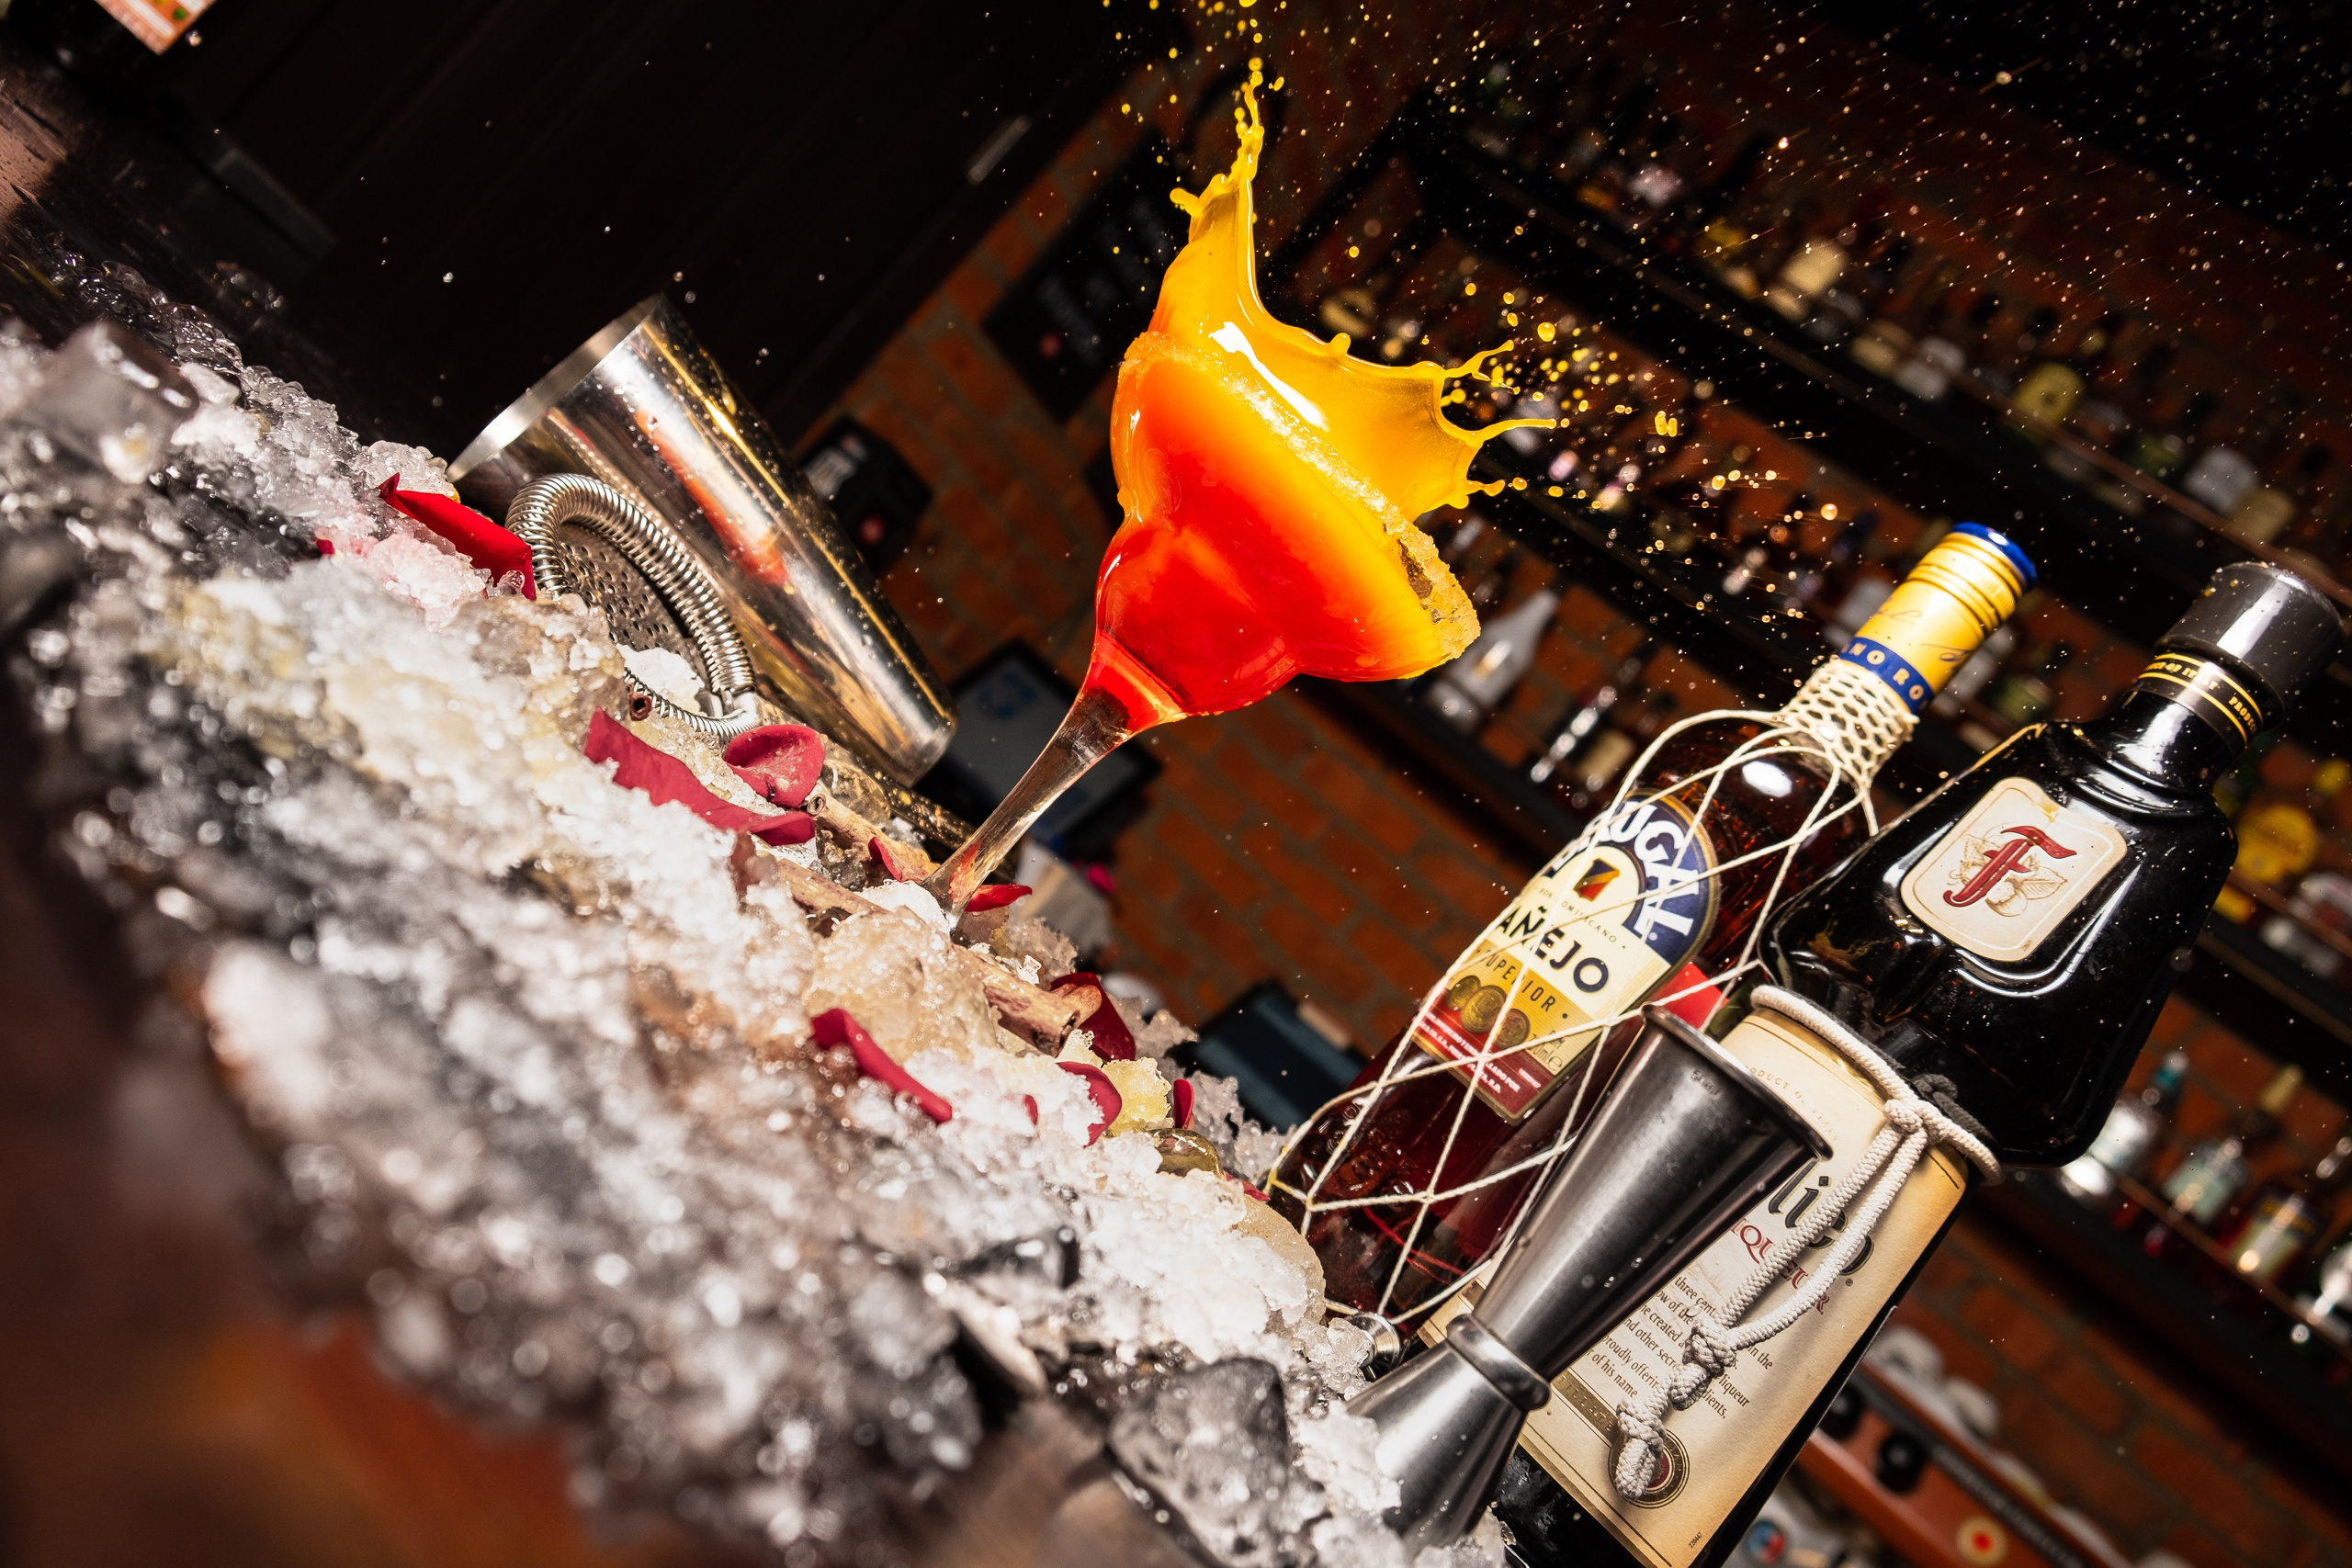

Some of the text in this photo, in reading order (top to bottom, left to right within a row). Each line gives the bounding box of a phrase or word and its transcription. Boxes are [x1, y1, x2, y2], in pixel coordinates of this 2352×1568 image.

[1841, 643, 1886, 666] NO
[2181, 667, 2220, 691] ITLY
[1558, 897, 1617, 943] OMICANO
[1494, 905, 1609, 993] AÑEJO
[1483, 949, 1556, 1012] UPEIOR
[1746, 1066, 1791, 1090] ODUCT
[1668, 1299, 1683, 1314] of
[1674, 1276, 1698, 1300] three
[1757, 1350, 1773, 1371] the
[1623, 1317, 1640, 1332] nd
[1634, 1327, 1660, 1351] other
[1657, 1348, 1679, 1370] secr
[1649, 1311, 1684, 1344] created
[1719, 1373, 1750, 1408] liqueur
[1591, 1352, 1606, 1366] of
[1600, 1356, 1616, 1378] his
[1613, 1373, 1638, 1399] name
